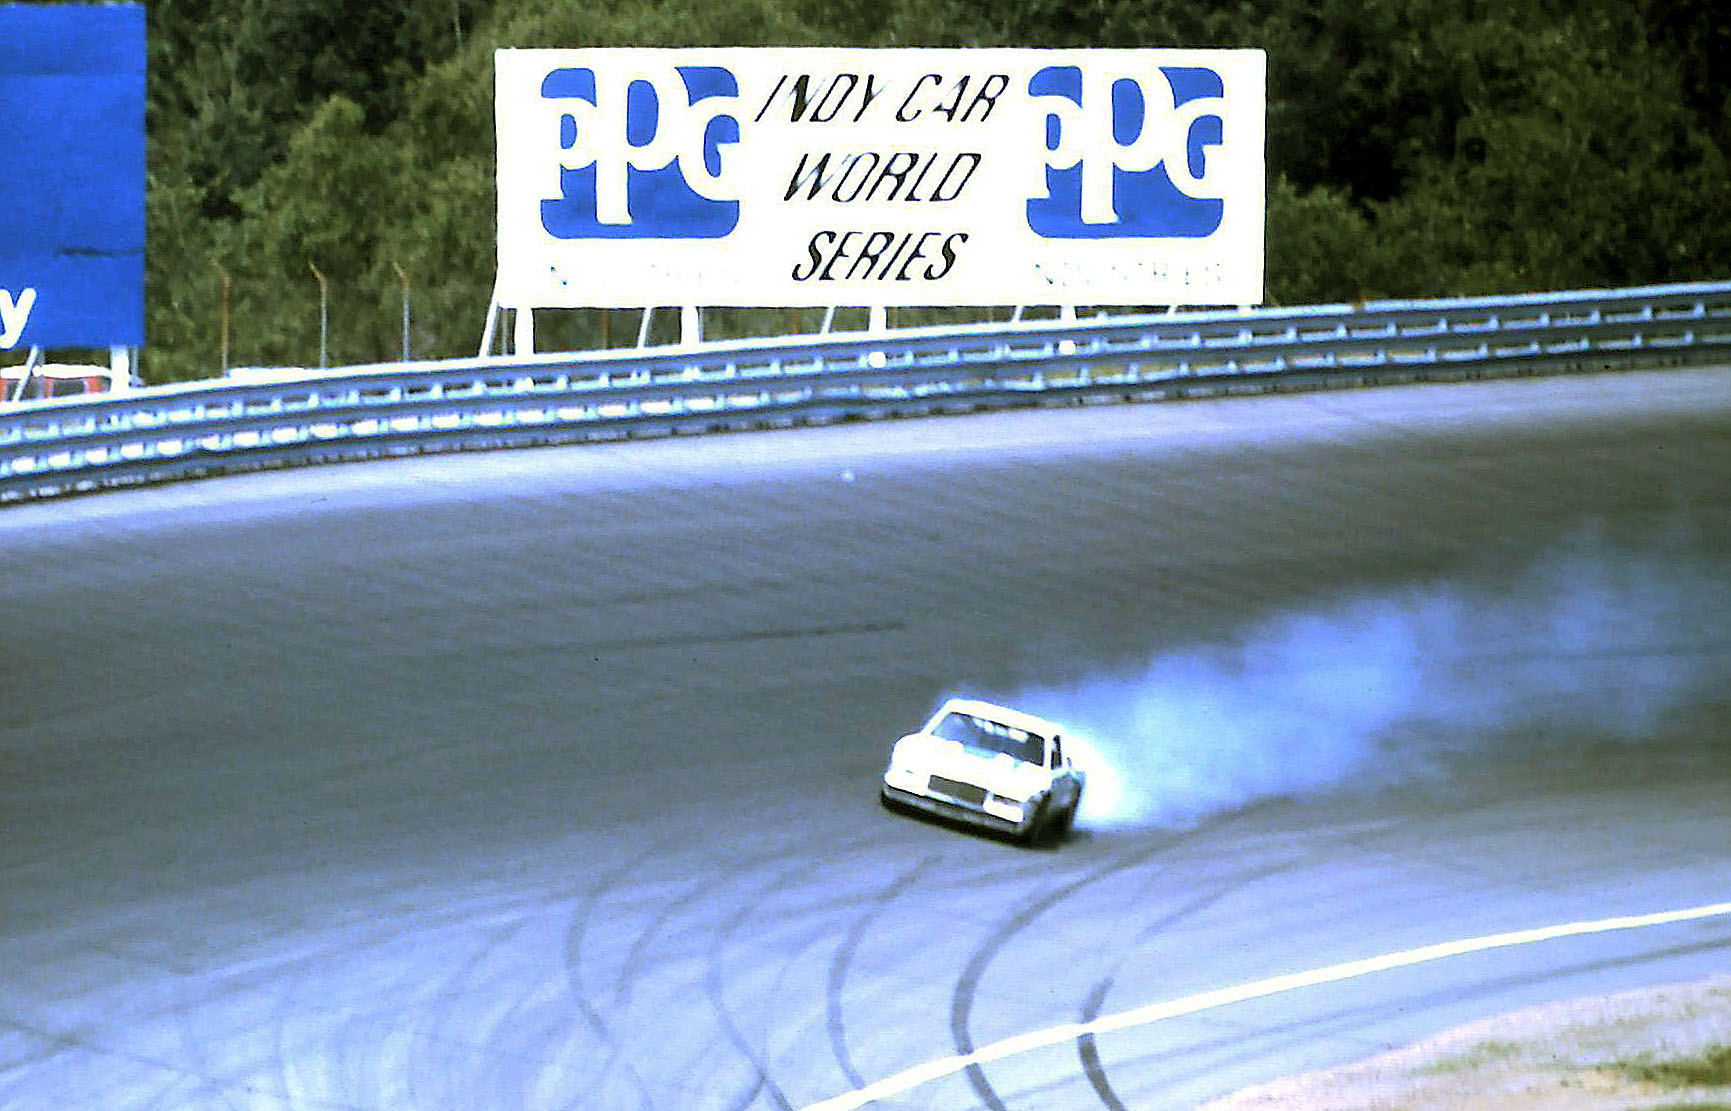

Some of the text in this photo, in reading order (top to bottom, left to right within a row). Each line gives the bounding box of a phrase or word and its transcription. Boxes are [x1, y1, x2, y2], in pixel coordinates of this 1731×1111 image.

[754, 73, 1009, 122] INDY CAR
[783, 152, 981, 202] WORLD
[791, 230, 969, 281] SERIES
